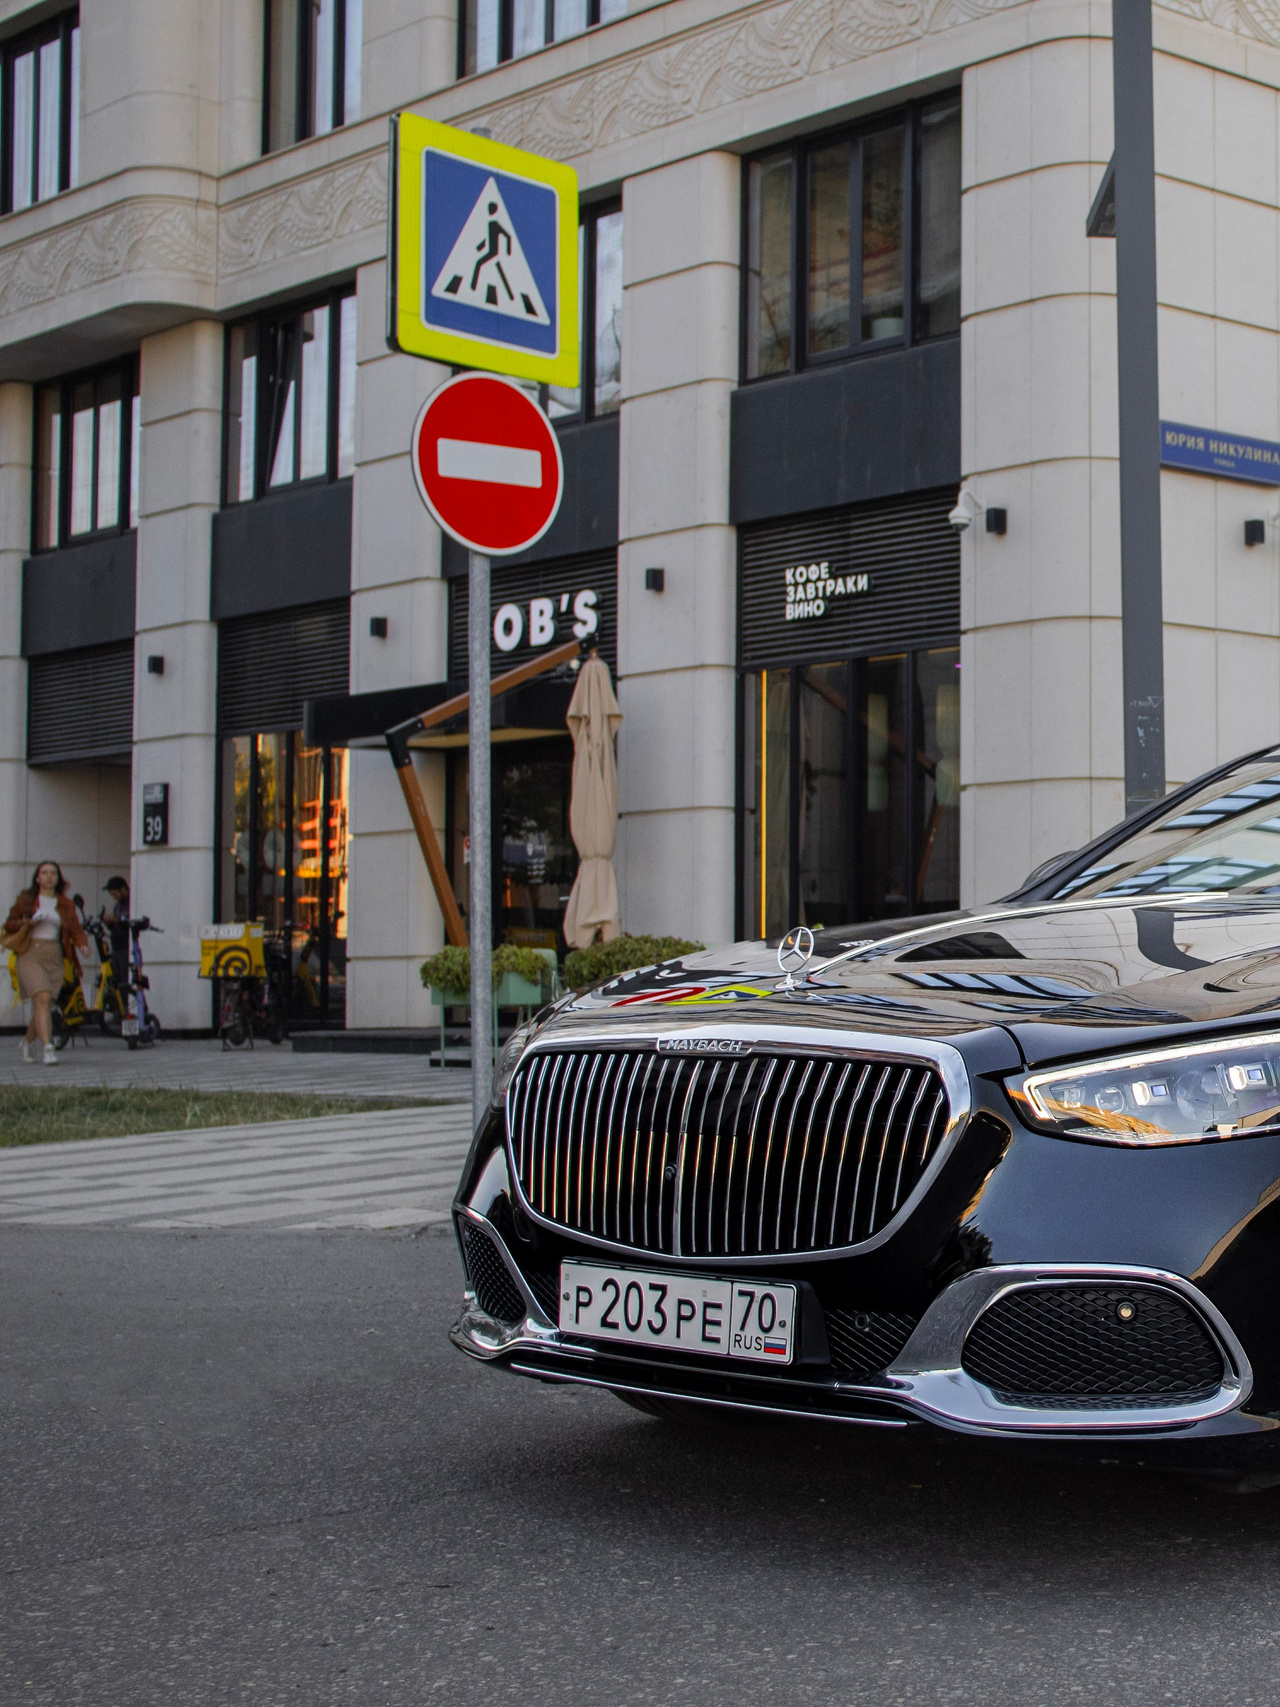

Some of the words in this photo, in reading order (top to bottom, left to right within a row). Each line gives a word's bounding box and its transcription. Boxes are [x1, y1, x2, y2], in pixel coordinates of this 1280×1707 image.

[1165, 431, 1205, 451] ЮРИЯ
[1209, 440, 1280, 465] НИКУЛИНА
[785, 562, 830, 585] КОФЕ
[786, 574, 869, 602] ЗАВТРАКИ
[493, 589, 599, 652] OB'S
[785, 599, 825, 621] ВИНО
[145, 816, 163, 842] 39
[666, 1039, 743, 1052] MAYBACH
[737, 1289, 778, 1333] 70
[733, 1333, 764, 1351] RUS
